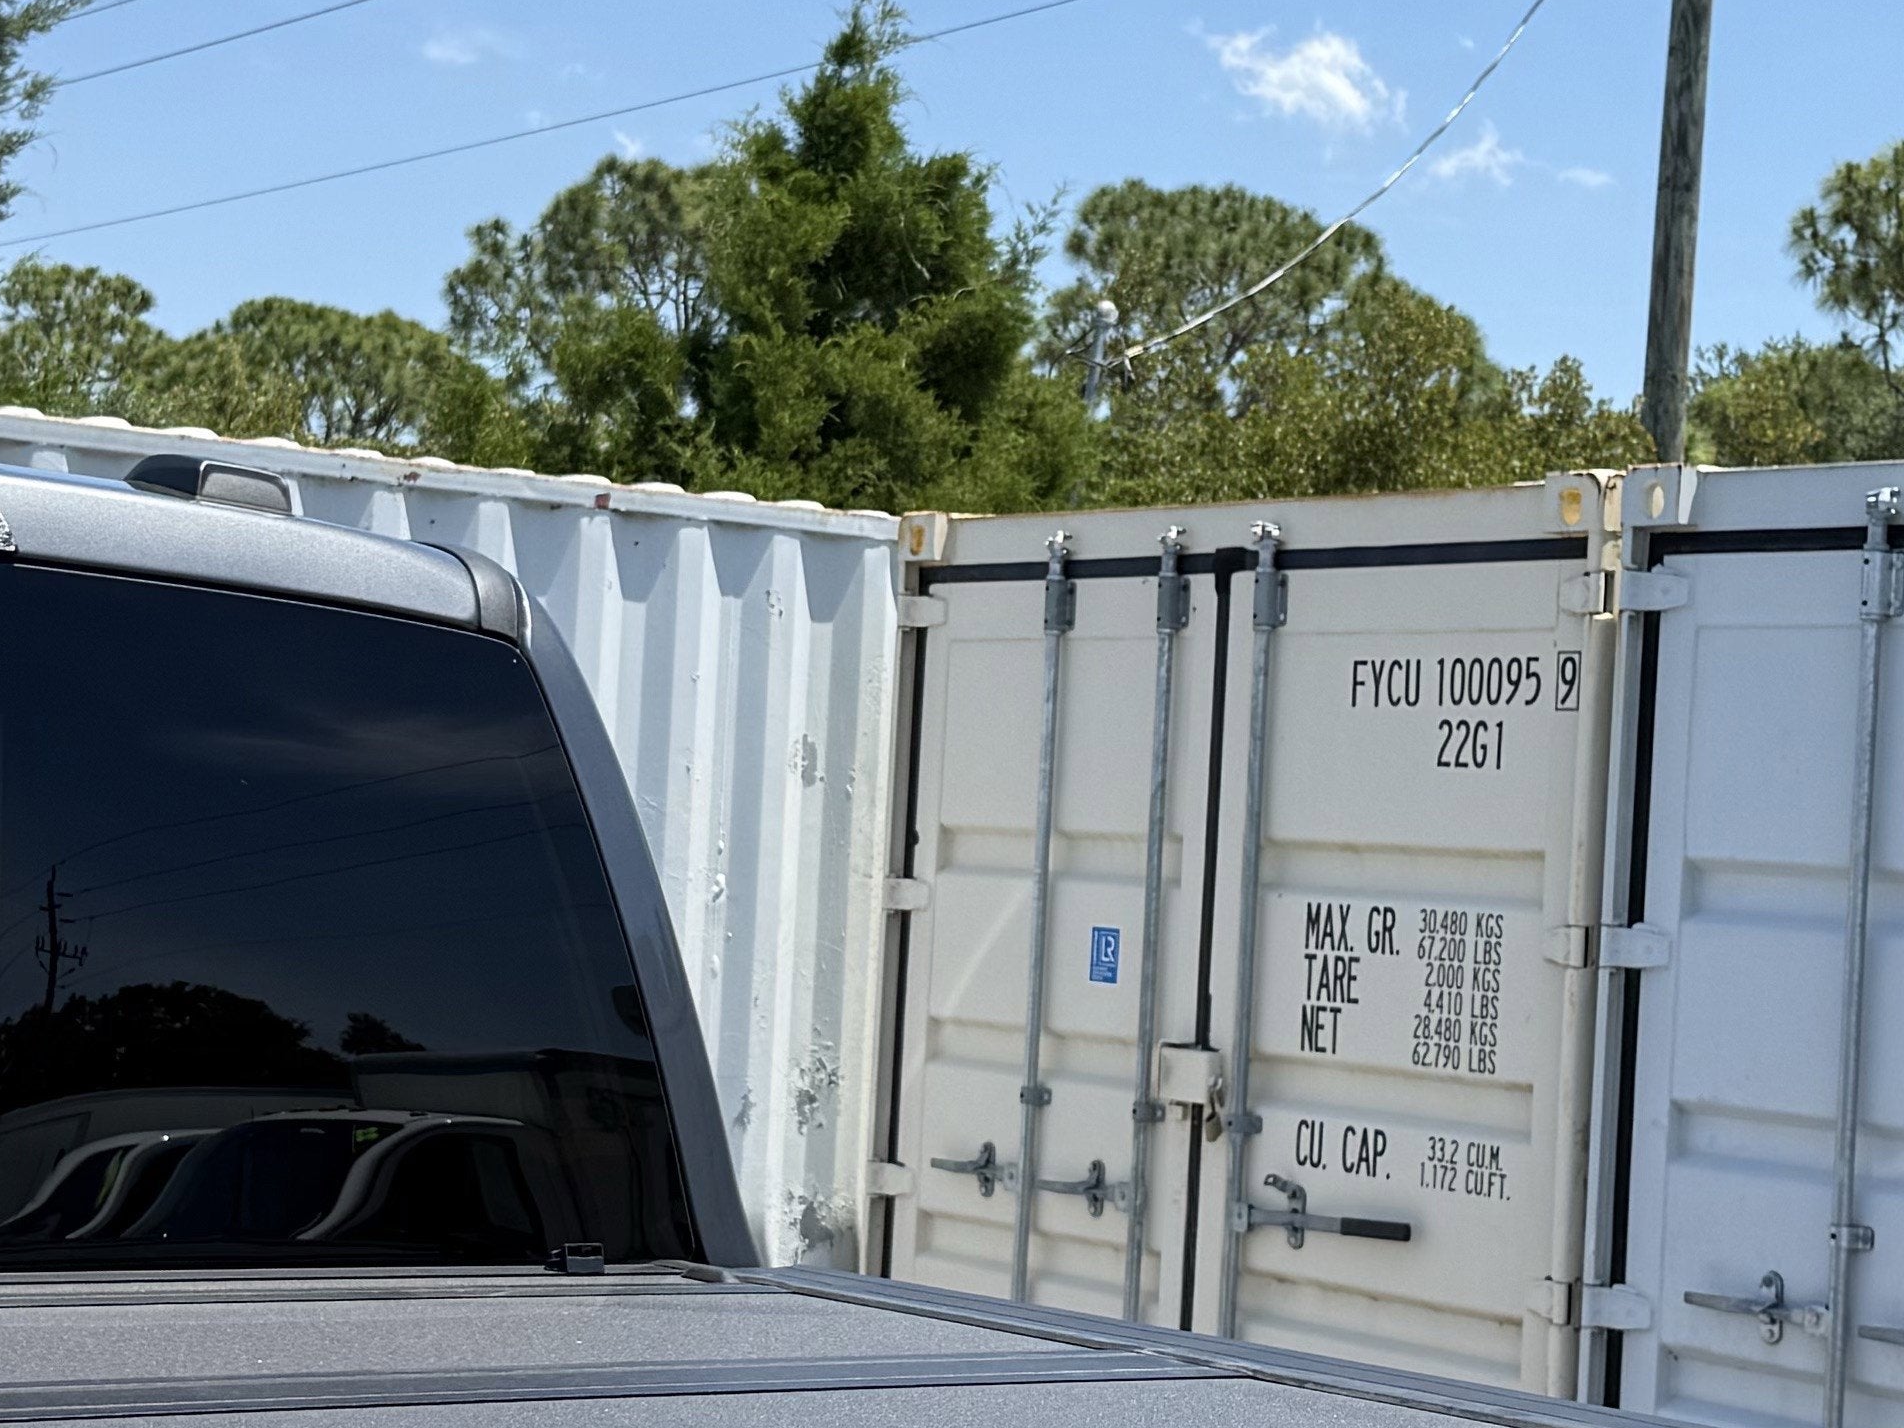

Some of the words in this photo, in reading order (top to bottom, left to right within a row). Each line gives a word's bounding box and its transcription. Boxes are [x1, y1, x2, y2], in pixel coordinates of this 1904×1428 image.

[1351, 658, 1422, 708] FYCU
[1436, 656, 1542, 707] 100095
[1558, 655, 1578, 706] 9
[1436, 718, 1504, 770] 22G1
[1304, 901, 1354, 953] MAX.
[1366, 905, 1400, 956] GR.
[1418, 908, 1468, 937] 30.480
[1475, 912, 1504, 940] KGS
[1417, 935, 1466, 964] 67.200
[1473, 939, 1502, 967] LBS
[1303, 953, 1361, 1005] TARE
[1424, 961, 1465, 990] 2.000
[1471, 966, 1501, 994] KGS
[1423, 988, 1463, 1017] 4.410
[1470, 993, 1500, 1021] LBS
[1300, 1003, 1343, 1055] NET
[1412, 1013, 1462, 1044] 28.480
[1469, 1020, 1498, 1048] KGS
[1411, 1041, 1461, 1071] 62.790
[1468, 1047, 1497, 1075] LBS
[1295, 1119, 1327, 1171] CU.
[1341, 1125, 1391, 1181] CAP.
[1427, 1135, 1460, 1165] 33.2
[1466, 1141, 1504, 1172] CU.M.
[1420, 1161, 1458, 1193] 1.172
[1465, 1168, 1512, 1201] CU.FT.
